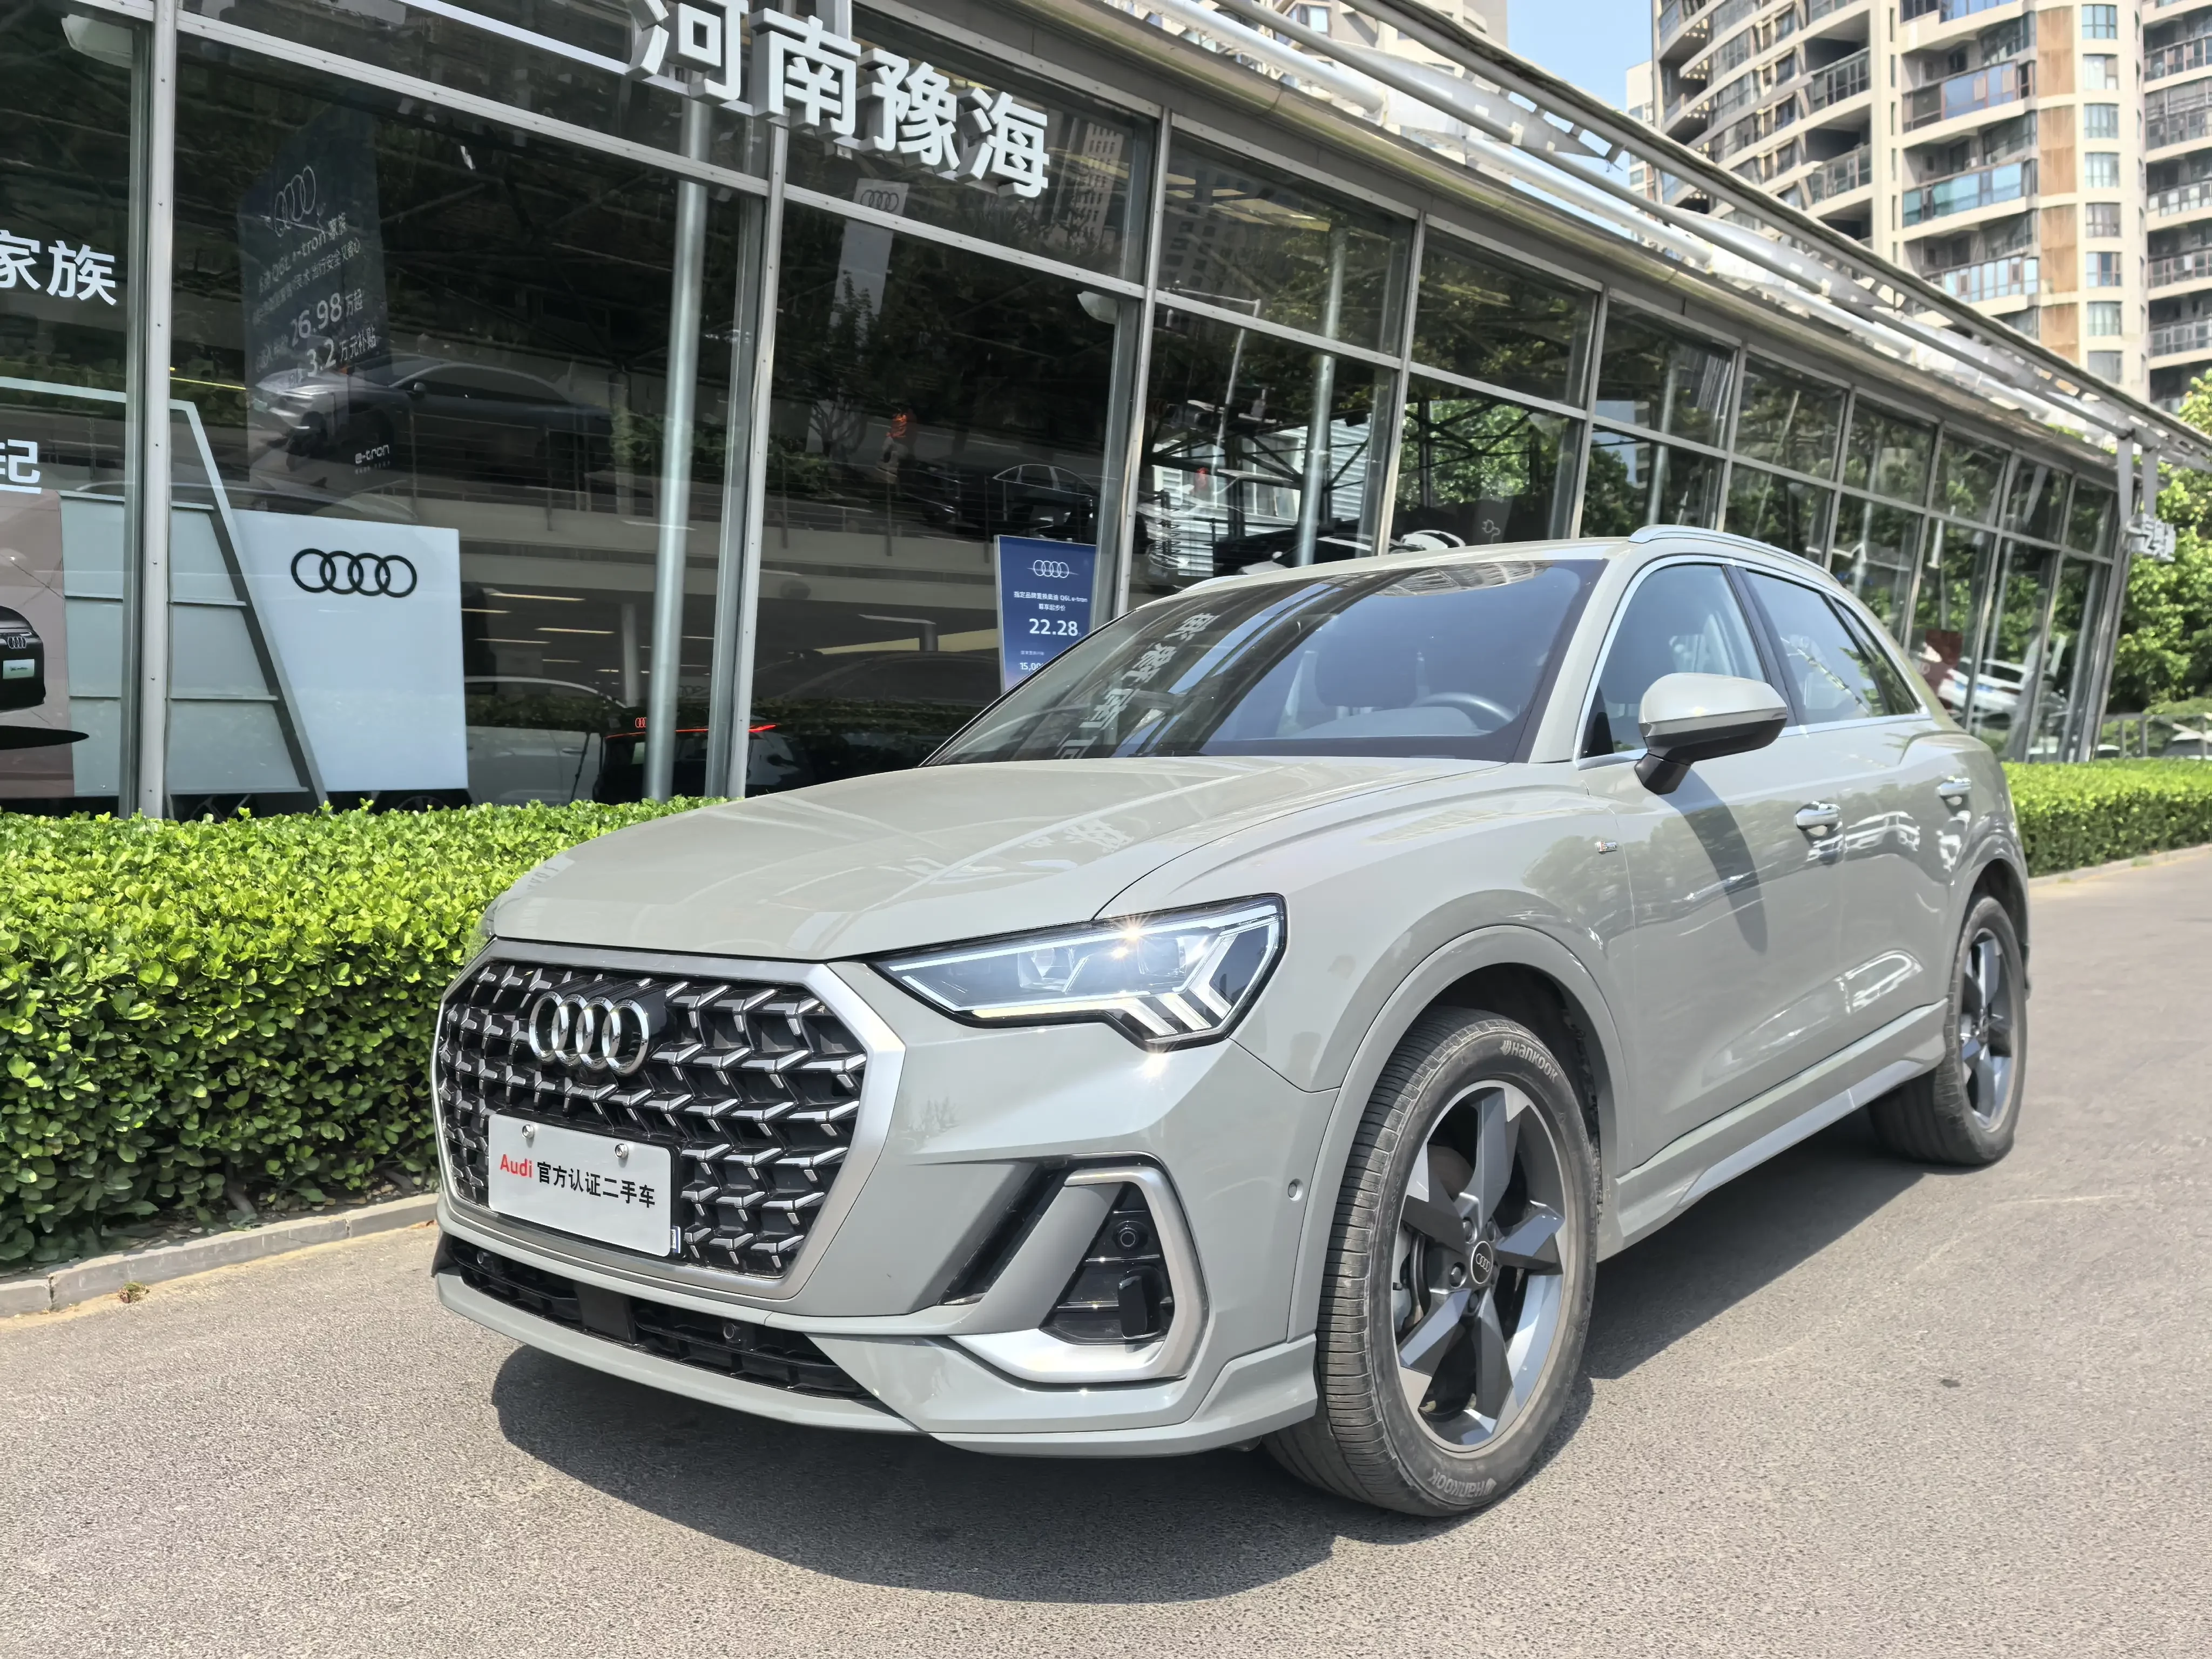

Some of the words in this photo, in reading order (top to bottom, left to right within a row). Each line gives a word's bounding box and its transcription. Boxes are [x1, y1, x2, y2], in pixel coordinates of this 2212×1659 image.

[626, 0, 1049, 198] 河南豫海
[0, 230, 117, 306] 家族
[1029, 618, 1078, 637] 22.28
[500, 1154, 533, 1178] Audi
[537, 1161, 656, 1209] 官方认证二手车
